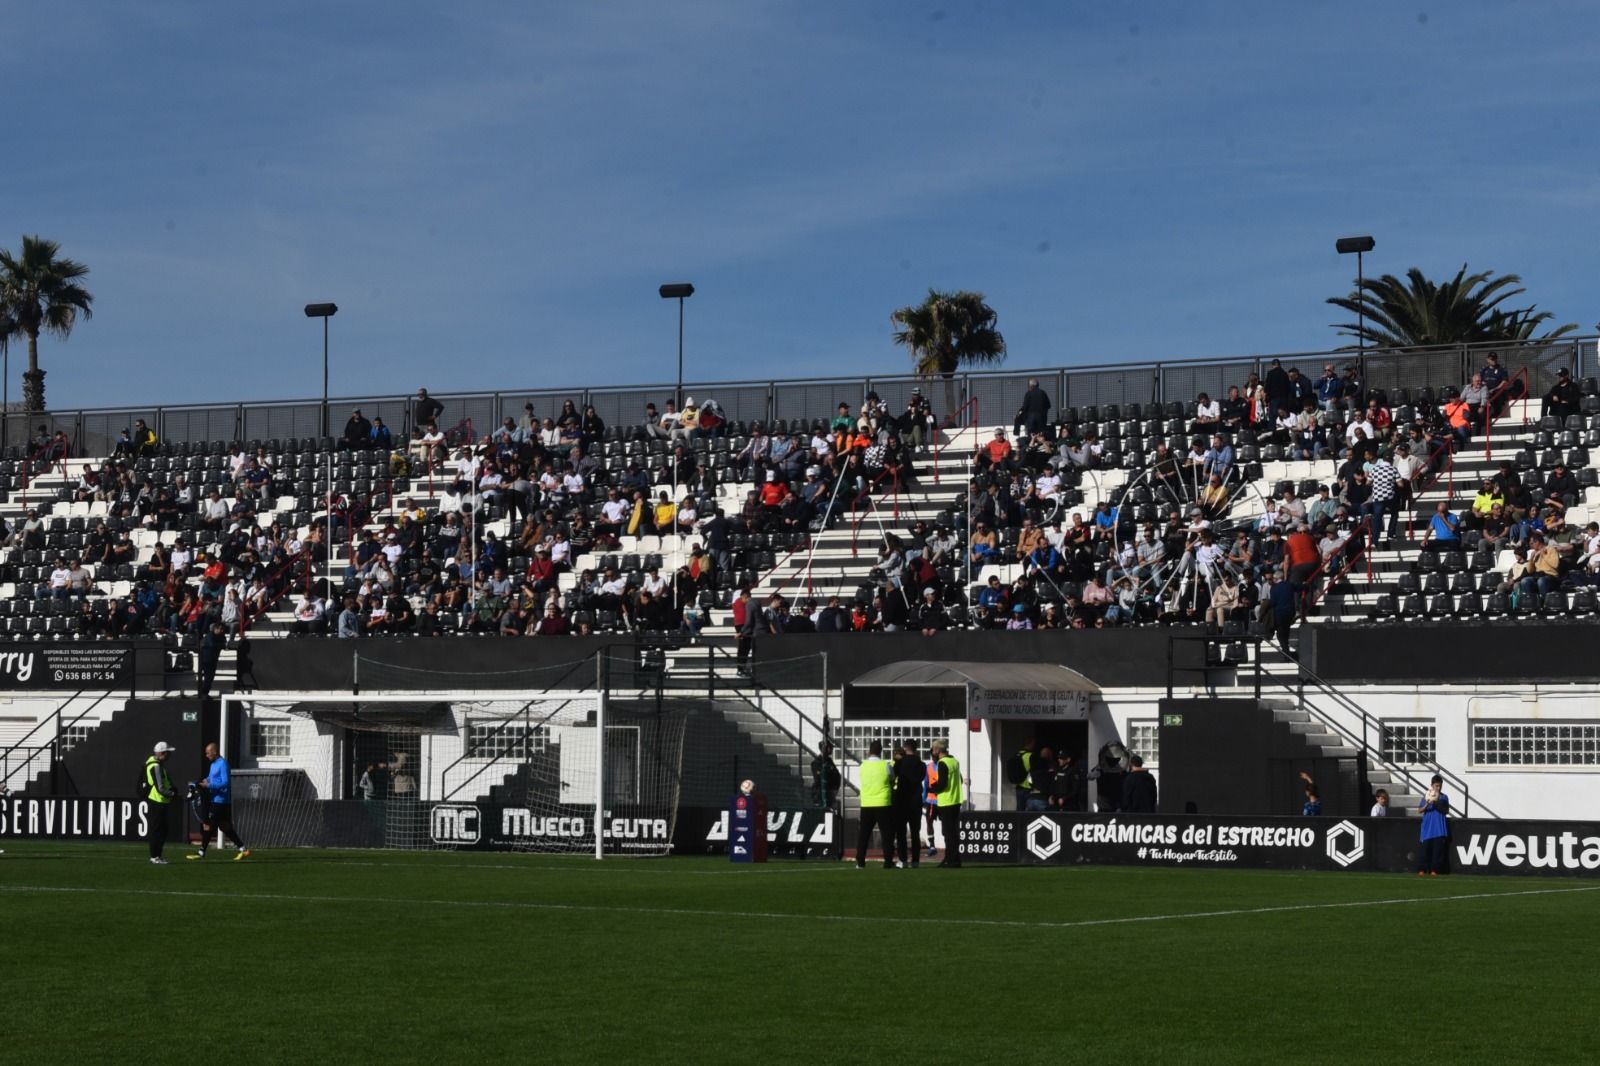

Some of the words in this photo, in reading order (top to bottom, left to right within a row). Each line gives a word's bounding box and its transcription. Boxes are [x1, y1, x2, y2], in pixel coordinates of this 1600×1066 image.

[65, 672, 80, 680] 636
[82, 672, 91, 680] 88
[105, 672, 115, 680] 54
[0, 799, 148, 836] SERVILIMPS
[436, 808, 476, 840] MC
[960, 820, 1013, 830] léfonos
[960, 830, 966, 840] 9
[968, 830, 980, 840] 30
[983, 830, 994, 840] 81
[996, 830, 1010, 840] 92
[1072, 818, 1178, 844] CERÁMICAS
[1182, 824, 1212, 845] del
[1218, 826, 1315, 847] ESTRECHO
[959, 844, 965, 854] 0
[968, 844, 980, 854] 83
[982, 844, 994, 854] 49
[996, 844, 1010, 854] 02
[1456, 831, 1600, 870] weuta
